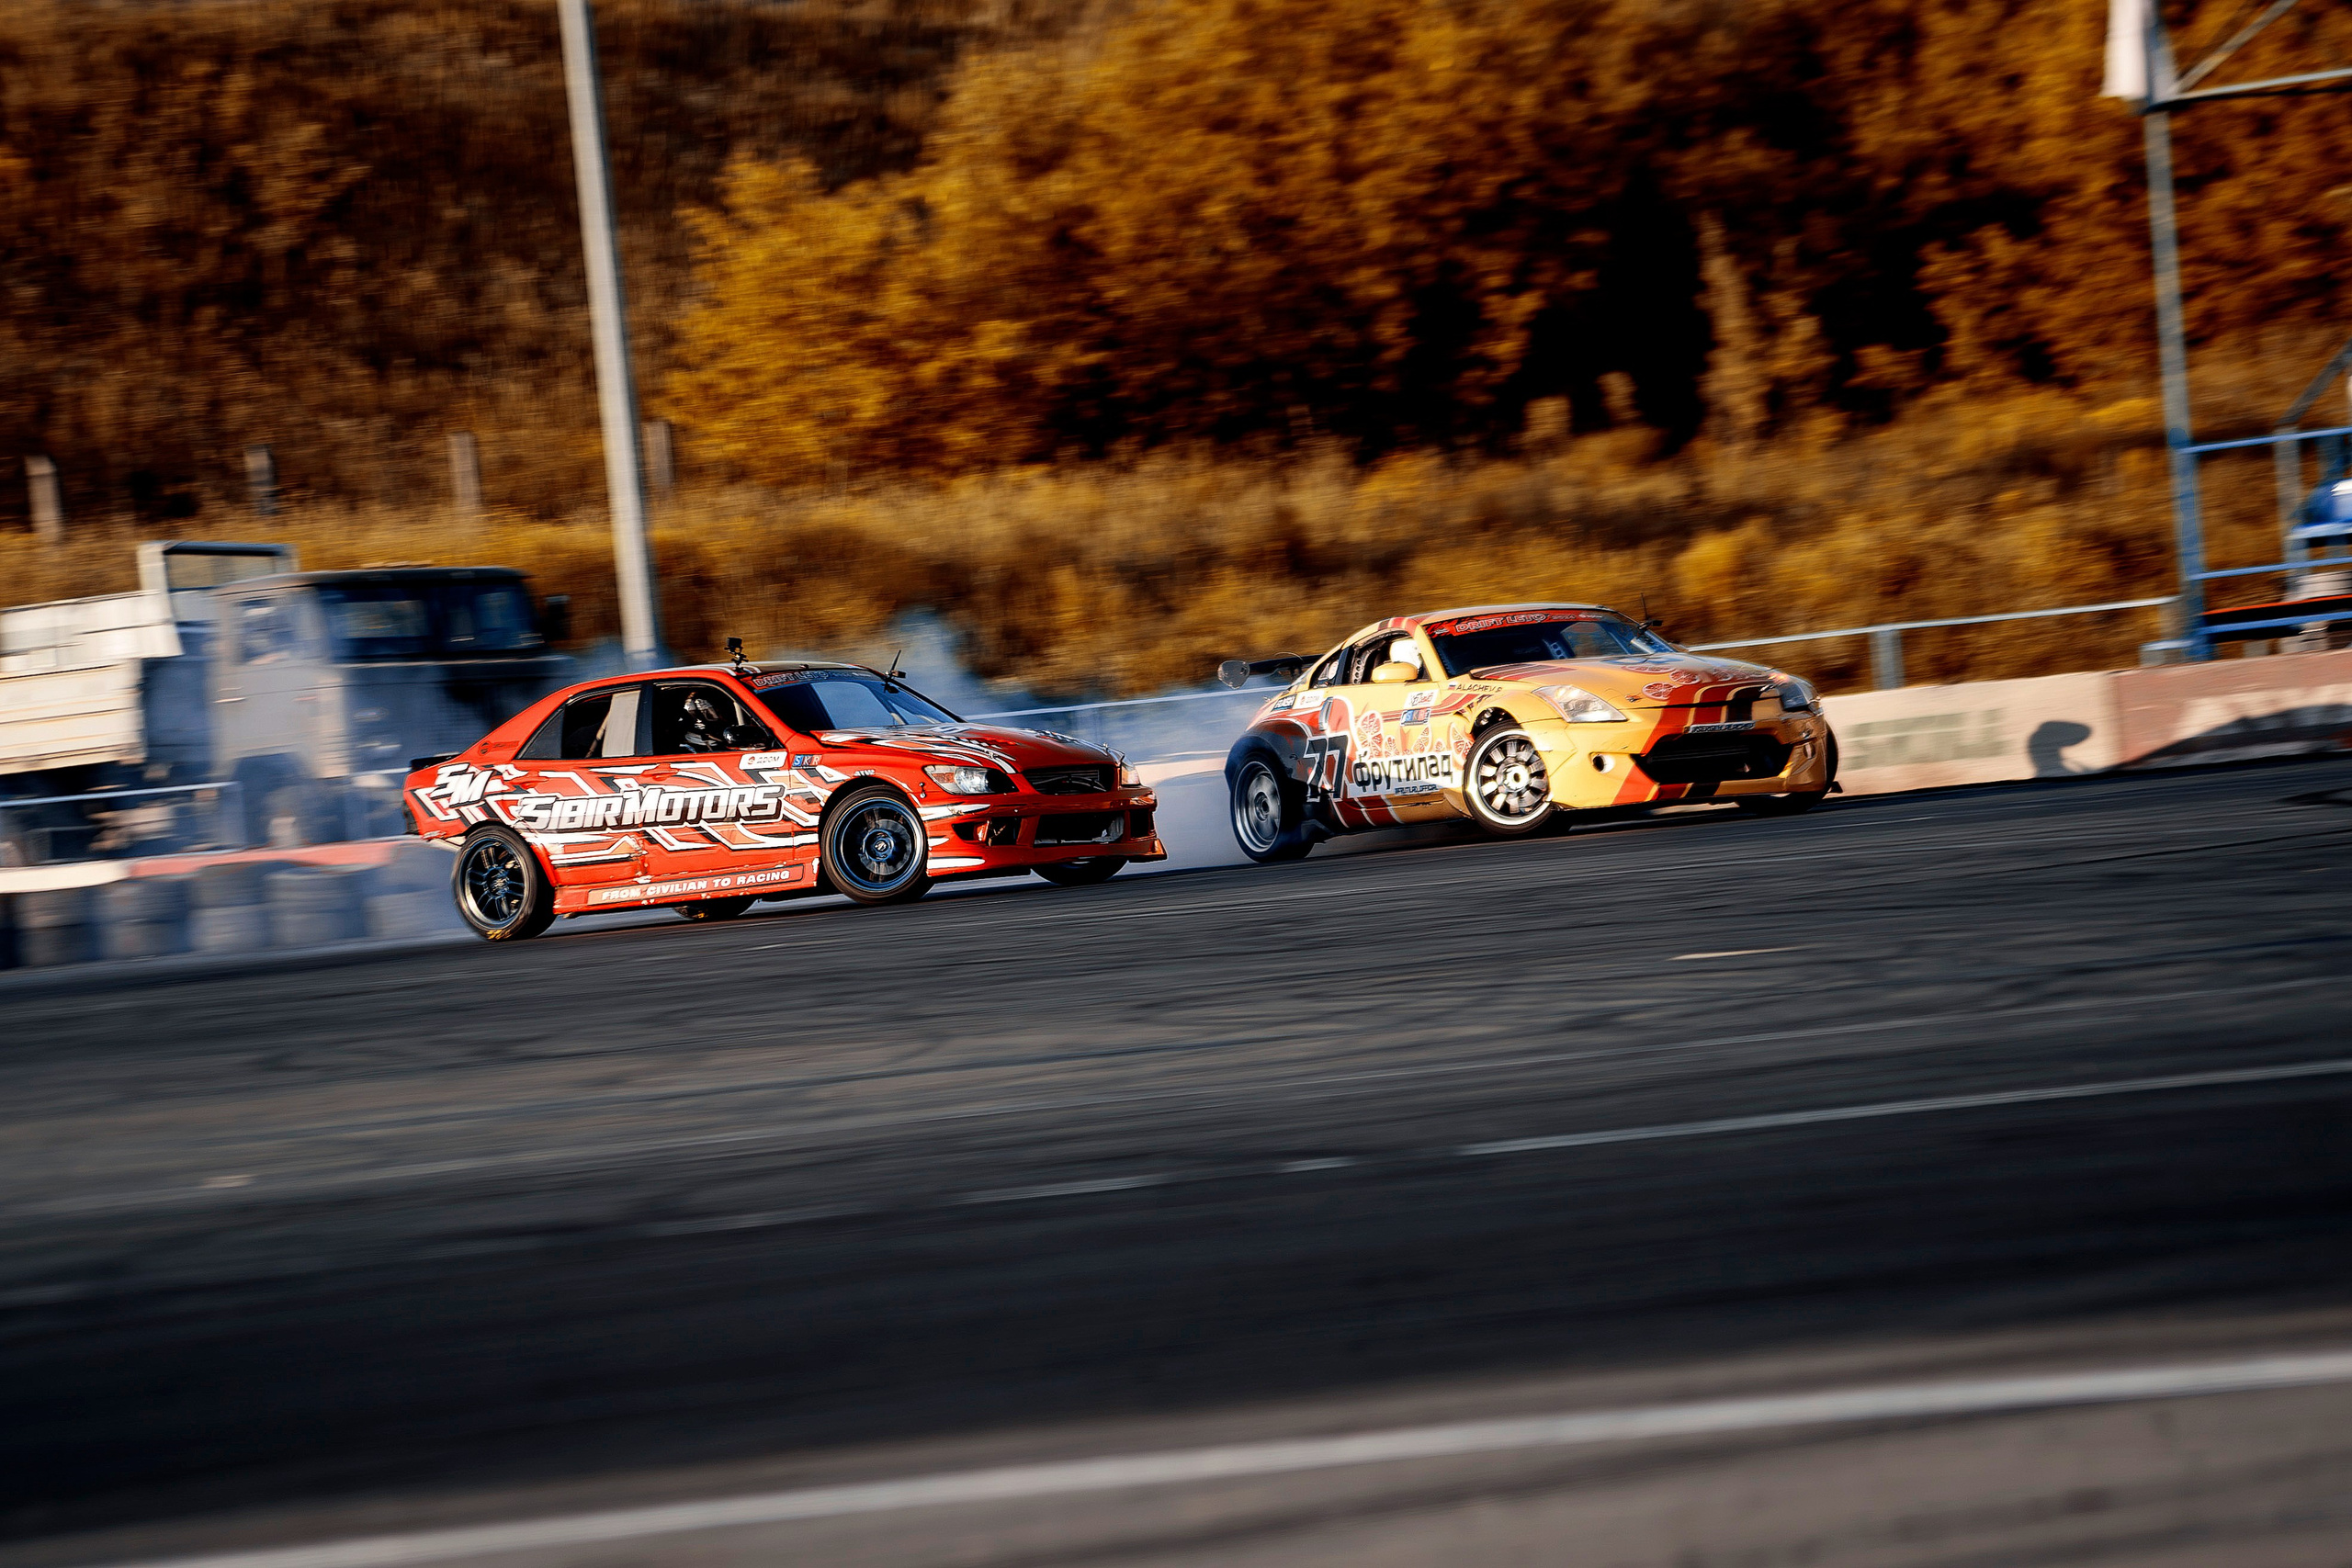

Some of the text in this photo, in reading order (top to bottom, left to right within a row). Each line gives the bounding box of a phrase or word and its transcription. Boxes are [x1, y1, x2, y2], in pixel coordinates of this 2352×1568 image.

[1455, 617, 1504, 632] DRIFT
[1506, 613, 1546, 624] LETO
[1456, 683, 1496, 692] ALACHEV
[794, 755, 821, 766] SKR
[1303, 732, 1349, 803] 77
[429, 763, 494, 808] SM
[602, 870, 790, 900] FROM CIVILIAN TO RACING
